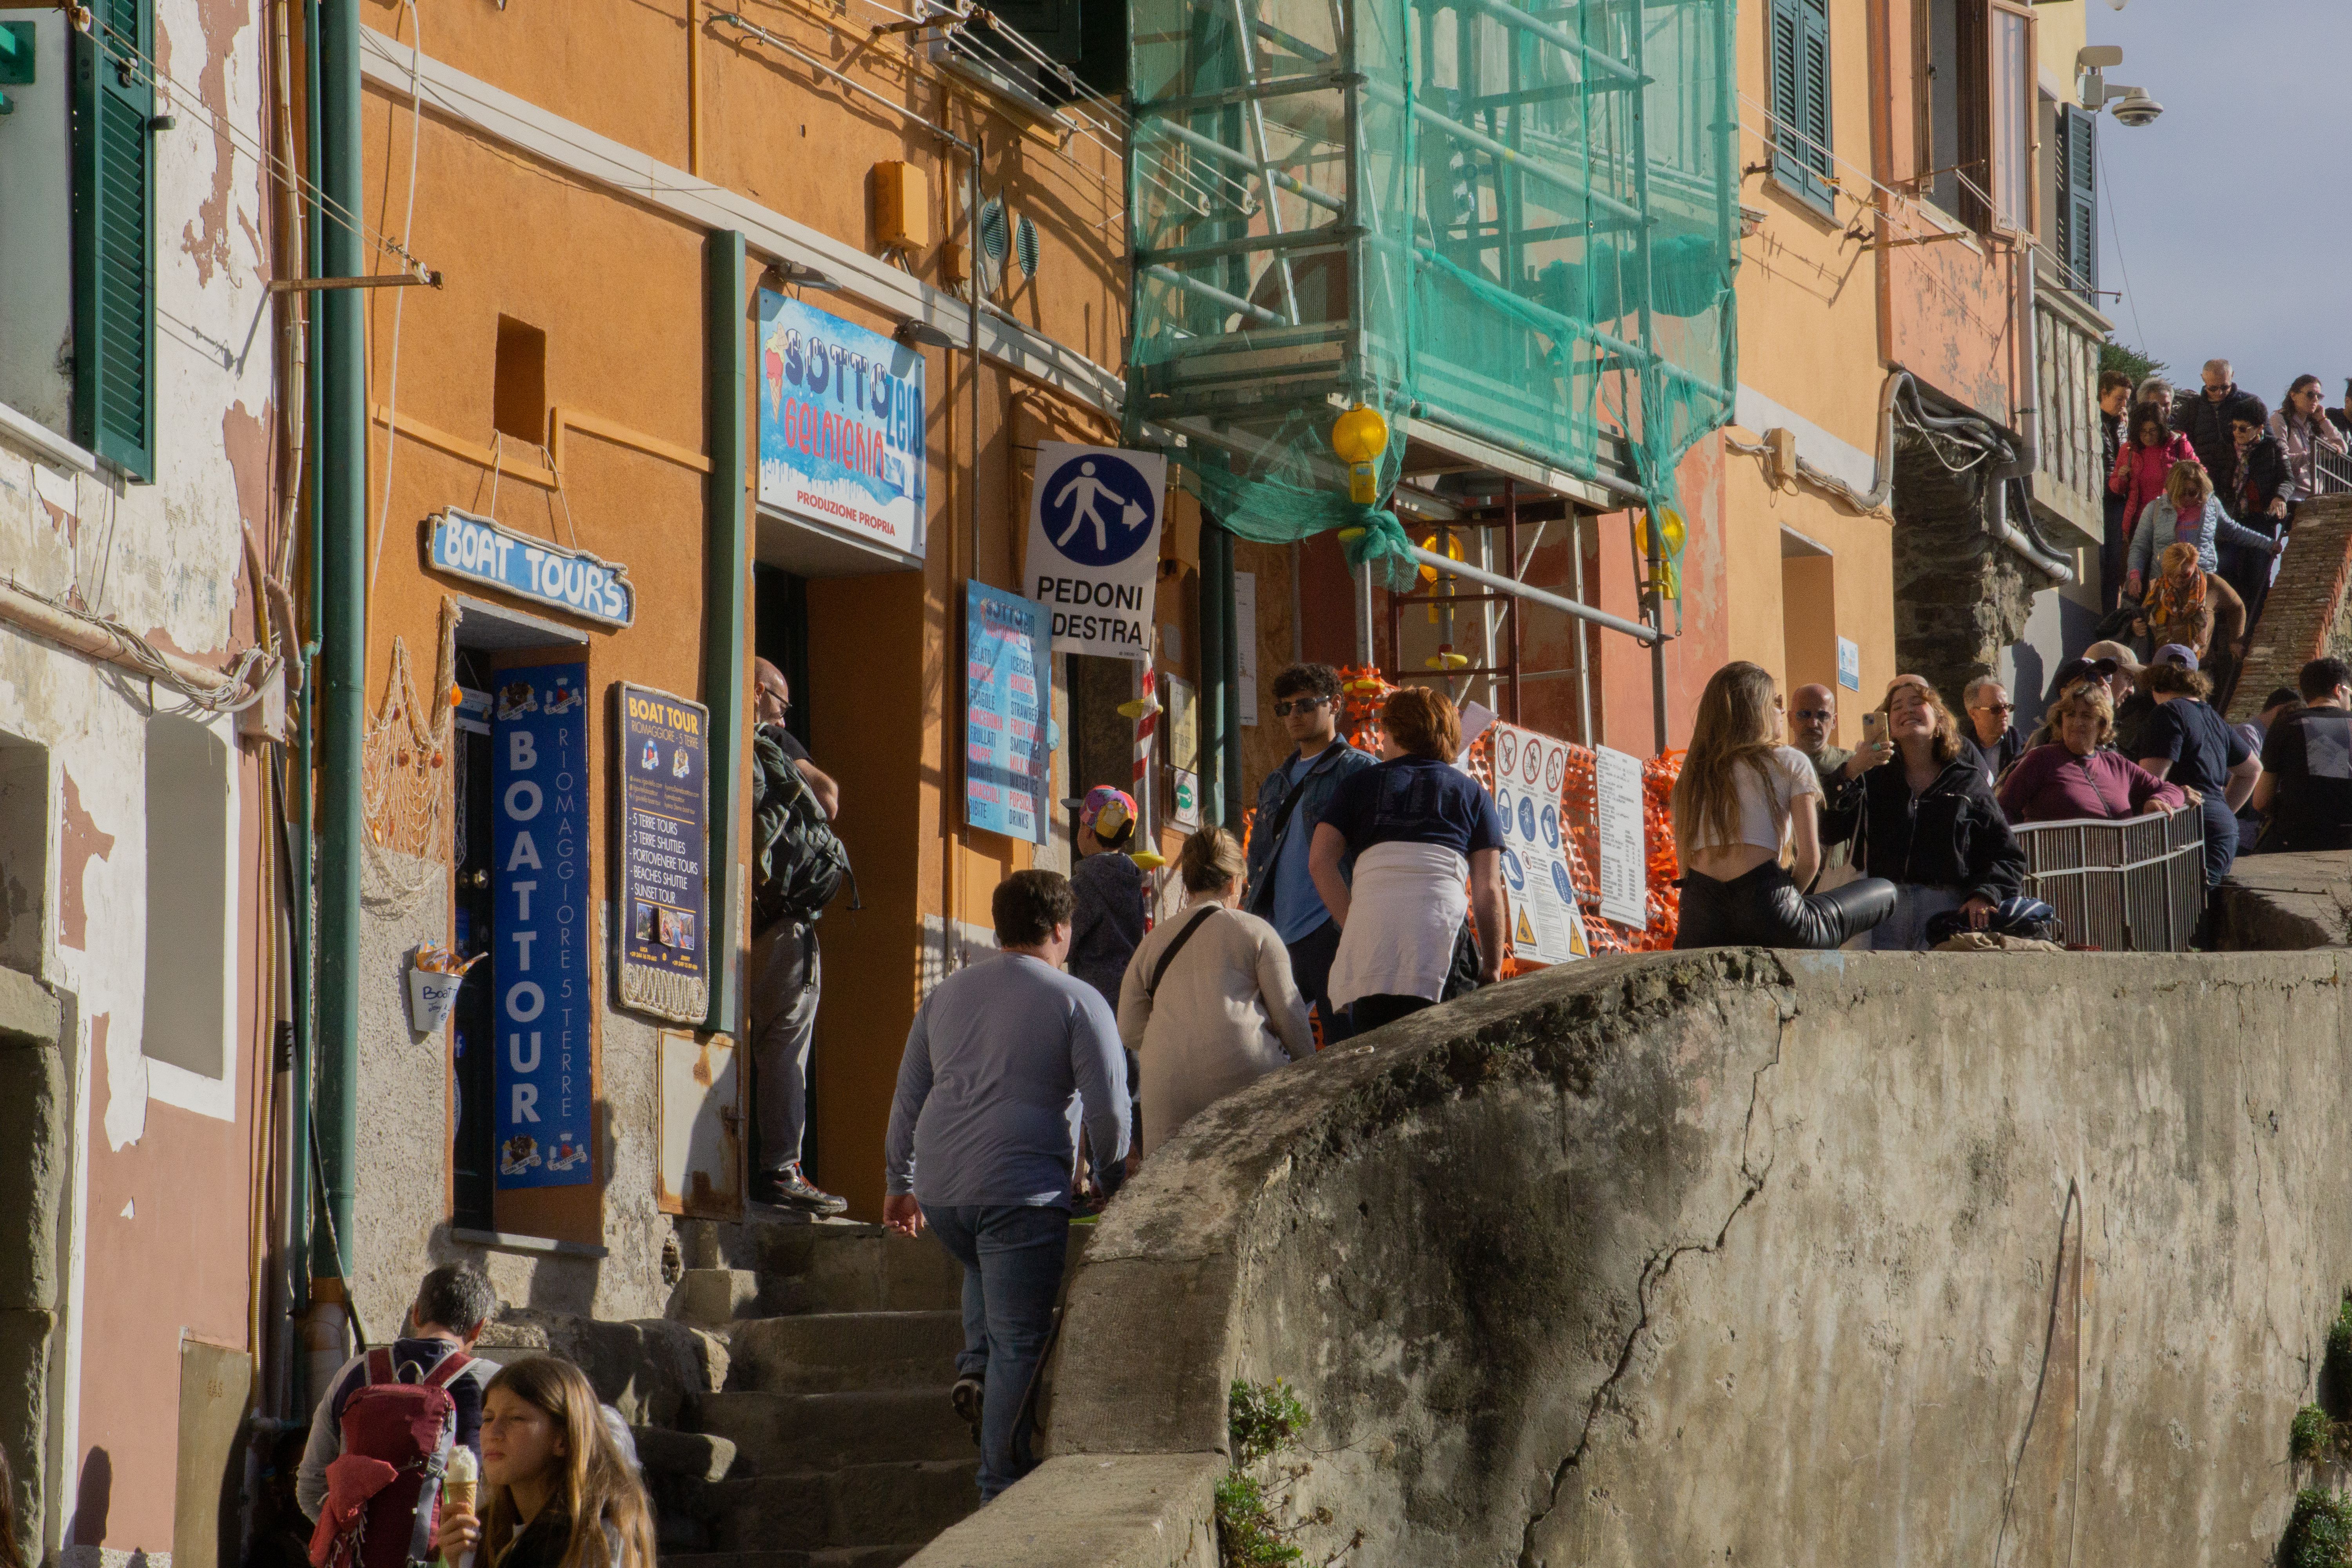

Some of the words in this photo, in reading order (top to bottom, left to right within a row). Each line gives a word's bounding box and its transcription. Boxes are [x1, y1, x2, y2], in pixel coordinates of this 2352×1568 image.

[786, 328, 890, 419] SOTTO
[797, 490, 857, 522] PRODUZIONE
[859, 512, 895, 537] PROPRIA
[444, 515, 514, 580] BOAT
[525, 548, 623, 617] TOURS
[1037, 576, 1143, 610] PEDONI
[1052, 612, 1142, 644] DESTRA
[970, 661, 994, 684] BRIOCHE
[1011, 673, 1033, 695] BRIOCHE
[969, 688, 995, 710] FRAGOLE
[629, 697, 664, 724] BOAT
[666, 706, 699, 735] TOUR
[969, 707, 1003, 731] MACEDONIA
[1011, 718, 1025, 736] FRUIT
[631, 720, 675, 743] RIOMAGGIORE
[969, 726, 996, 747] FRULLATI
[1010, 754, 1024, 773] MILK
[969, 780, 1000, 804] GHIACCIOLI
[1009, 773, 1028, 792] WATER
[969, 799, 987, 818] BIBITE
[1009, 790, 1038, 813] POPSICLES
[632, 812, 637, 825] 5
[639, 814, 656, 830] TERRE
[657, 818, 678, 835] TOURS
[1009, 809, 1029, 829] DRINKS
[633, 830, 638, 843] 5
[639, 831, 656, 848] TERRE
[657, 836, 686, 855] SHUTTLES
[633, 848, 676, 870] PORTOVENERE
[677, 858, 698, 875] TOURS
[633, 865, 662, 884] BEACHES
[663, 871, 688, 890] SHUTTLE
[634, 883, 657, 901] SUNSET
[659, 887, 675, 904] TOUR
[423, 985, 453, 1000] Boat
[559, 979, 572, 998] 5
[560, 1008, 572, 1116] TERRE
